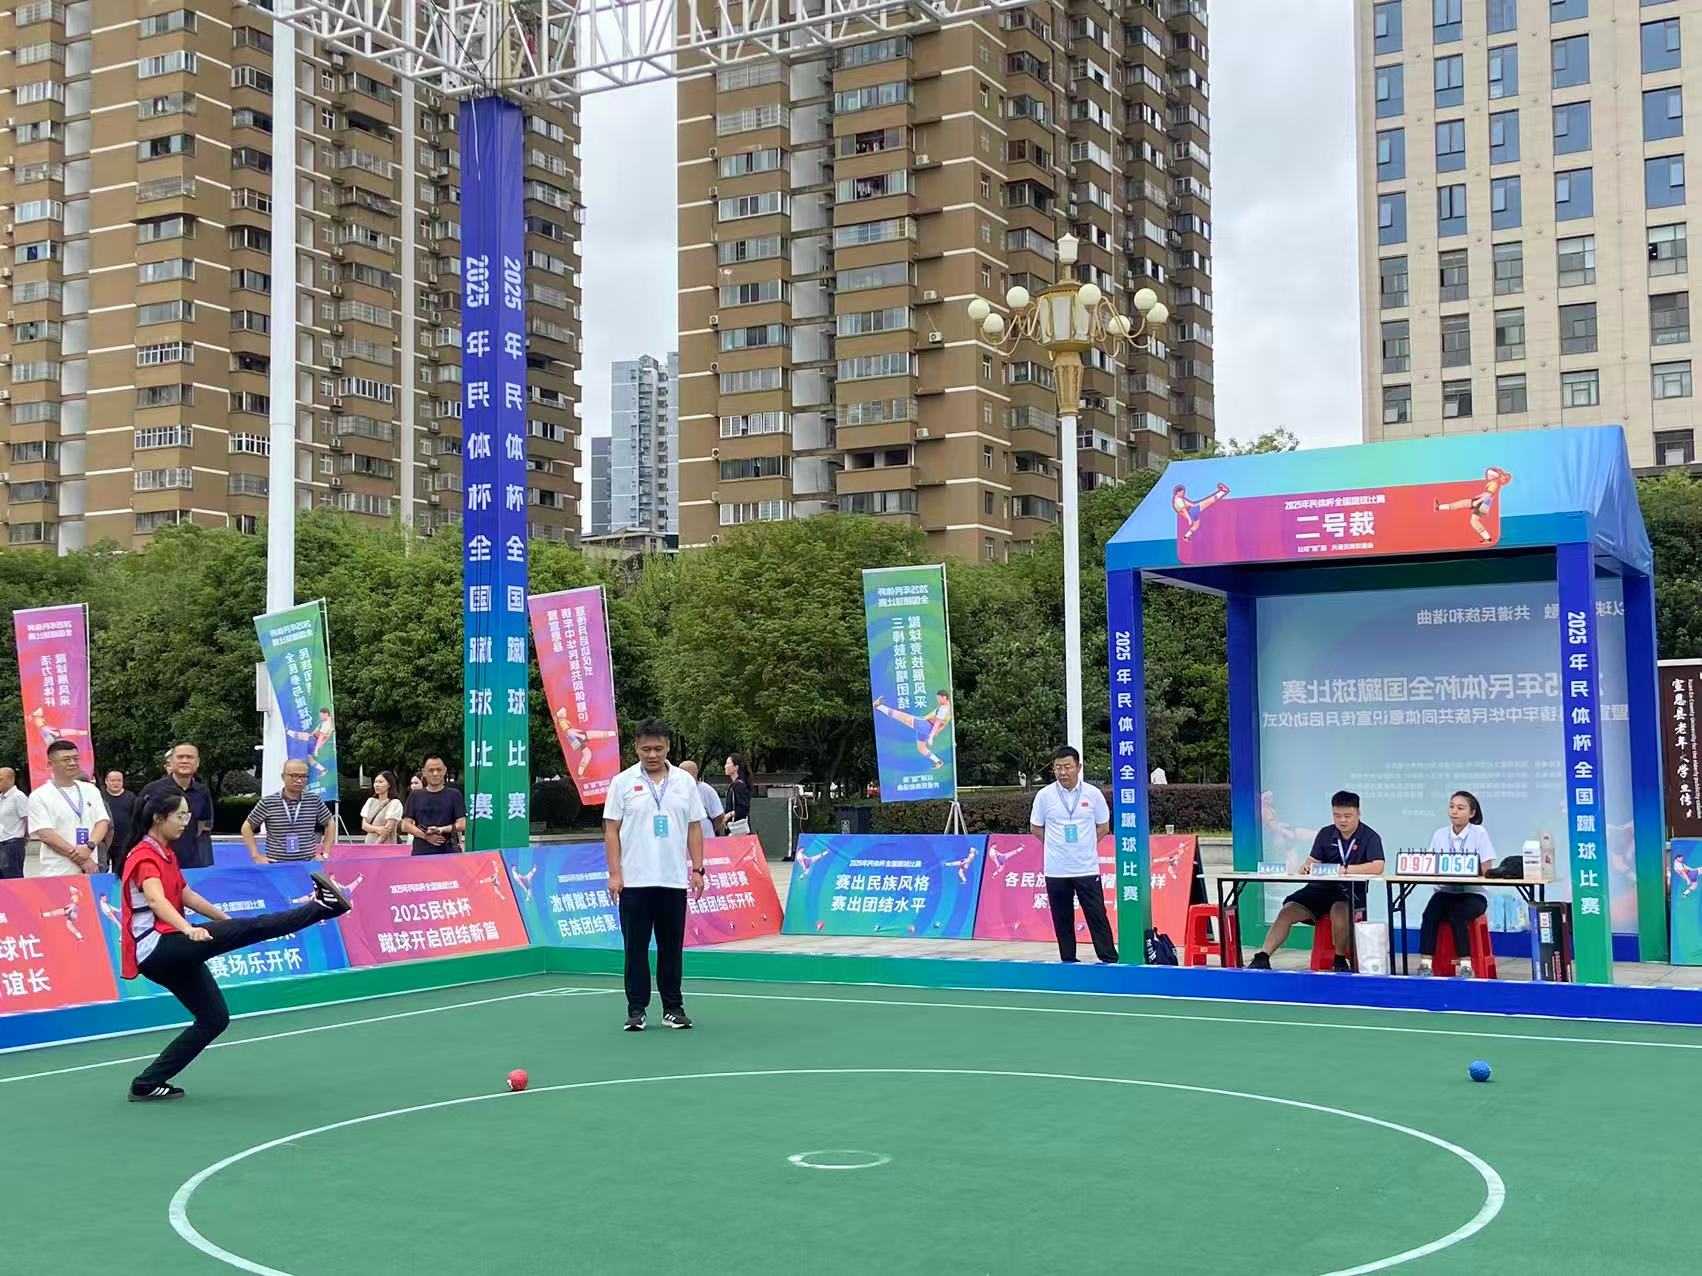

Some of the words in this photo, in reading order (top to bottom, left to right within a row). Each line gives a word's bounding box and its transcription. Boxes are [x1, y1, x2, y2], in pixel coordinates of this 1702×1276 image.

[1284, 494, 1386, 510] 2025年民体杯全国蹴球比赛
[466, 254, 493, 820] 2025年民体杯全国蹴球比赛
[504, 256, 526, 820] 2025年民体杯全国蹴球比赛
[1296, 511, 1375, 539] 二号裁
[1115, 631, 1139, 901] 2025年民体杯全国蹴球比赛
[1568, 611, 1600, 915] 2025年民体杯全国蹴球比赛
[1401, 856, 1432, 872] 097
[1442, 856, 1475, 872] 054
[687, 871, 749, 892] 参与蹴球赛
[834, 874, 930, 892] 赛出民族风格
[390, 897, 472, 923] 2025民体杯
[831, 895, 927, 914] 赛出团结水平
[377, 921, 500, 953] 蹴球开启团结新篇
[558, 914, 621, 938] 民族团结聚
[0, 967, 51, 996] 谊长
